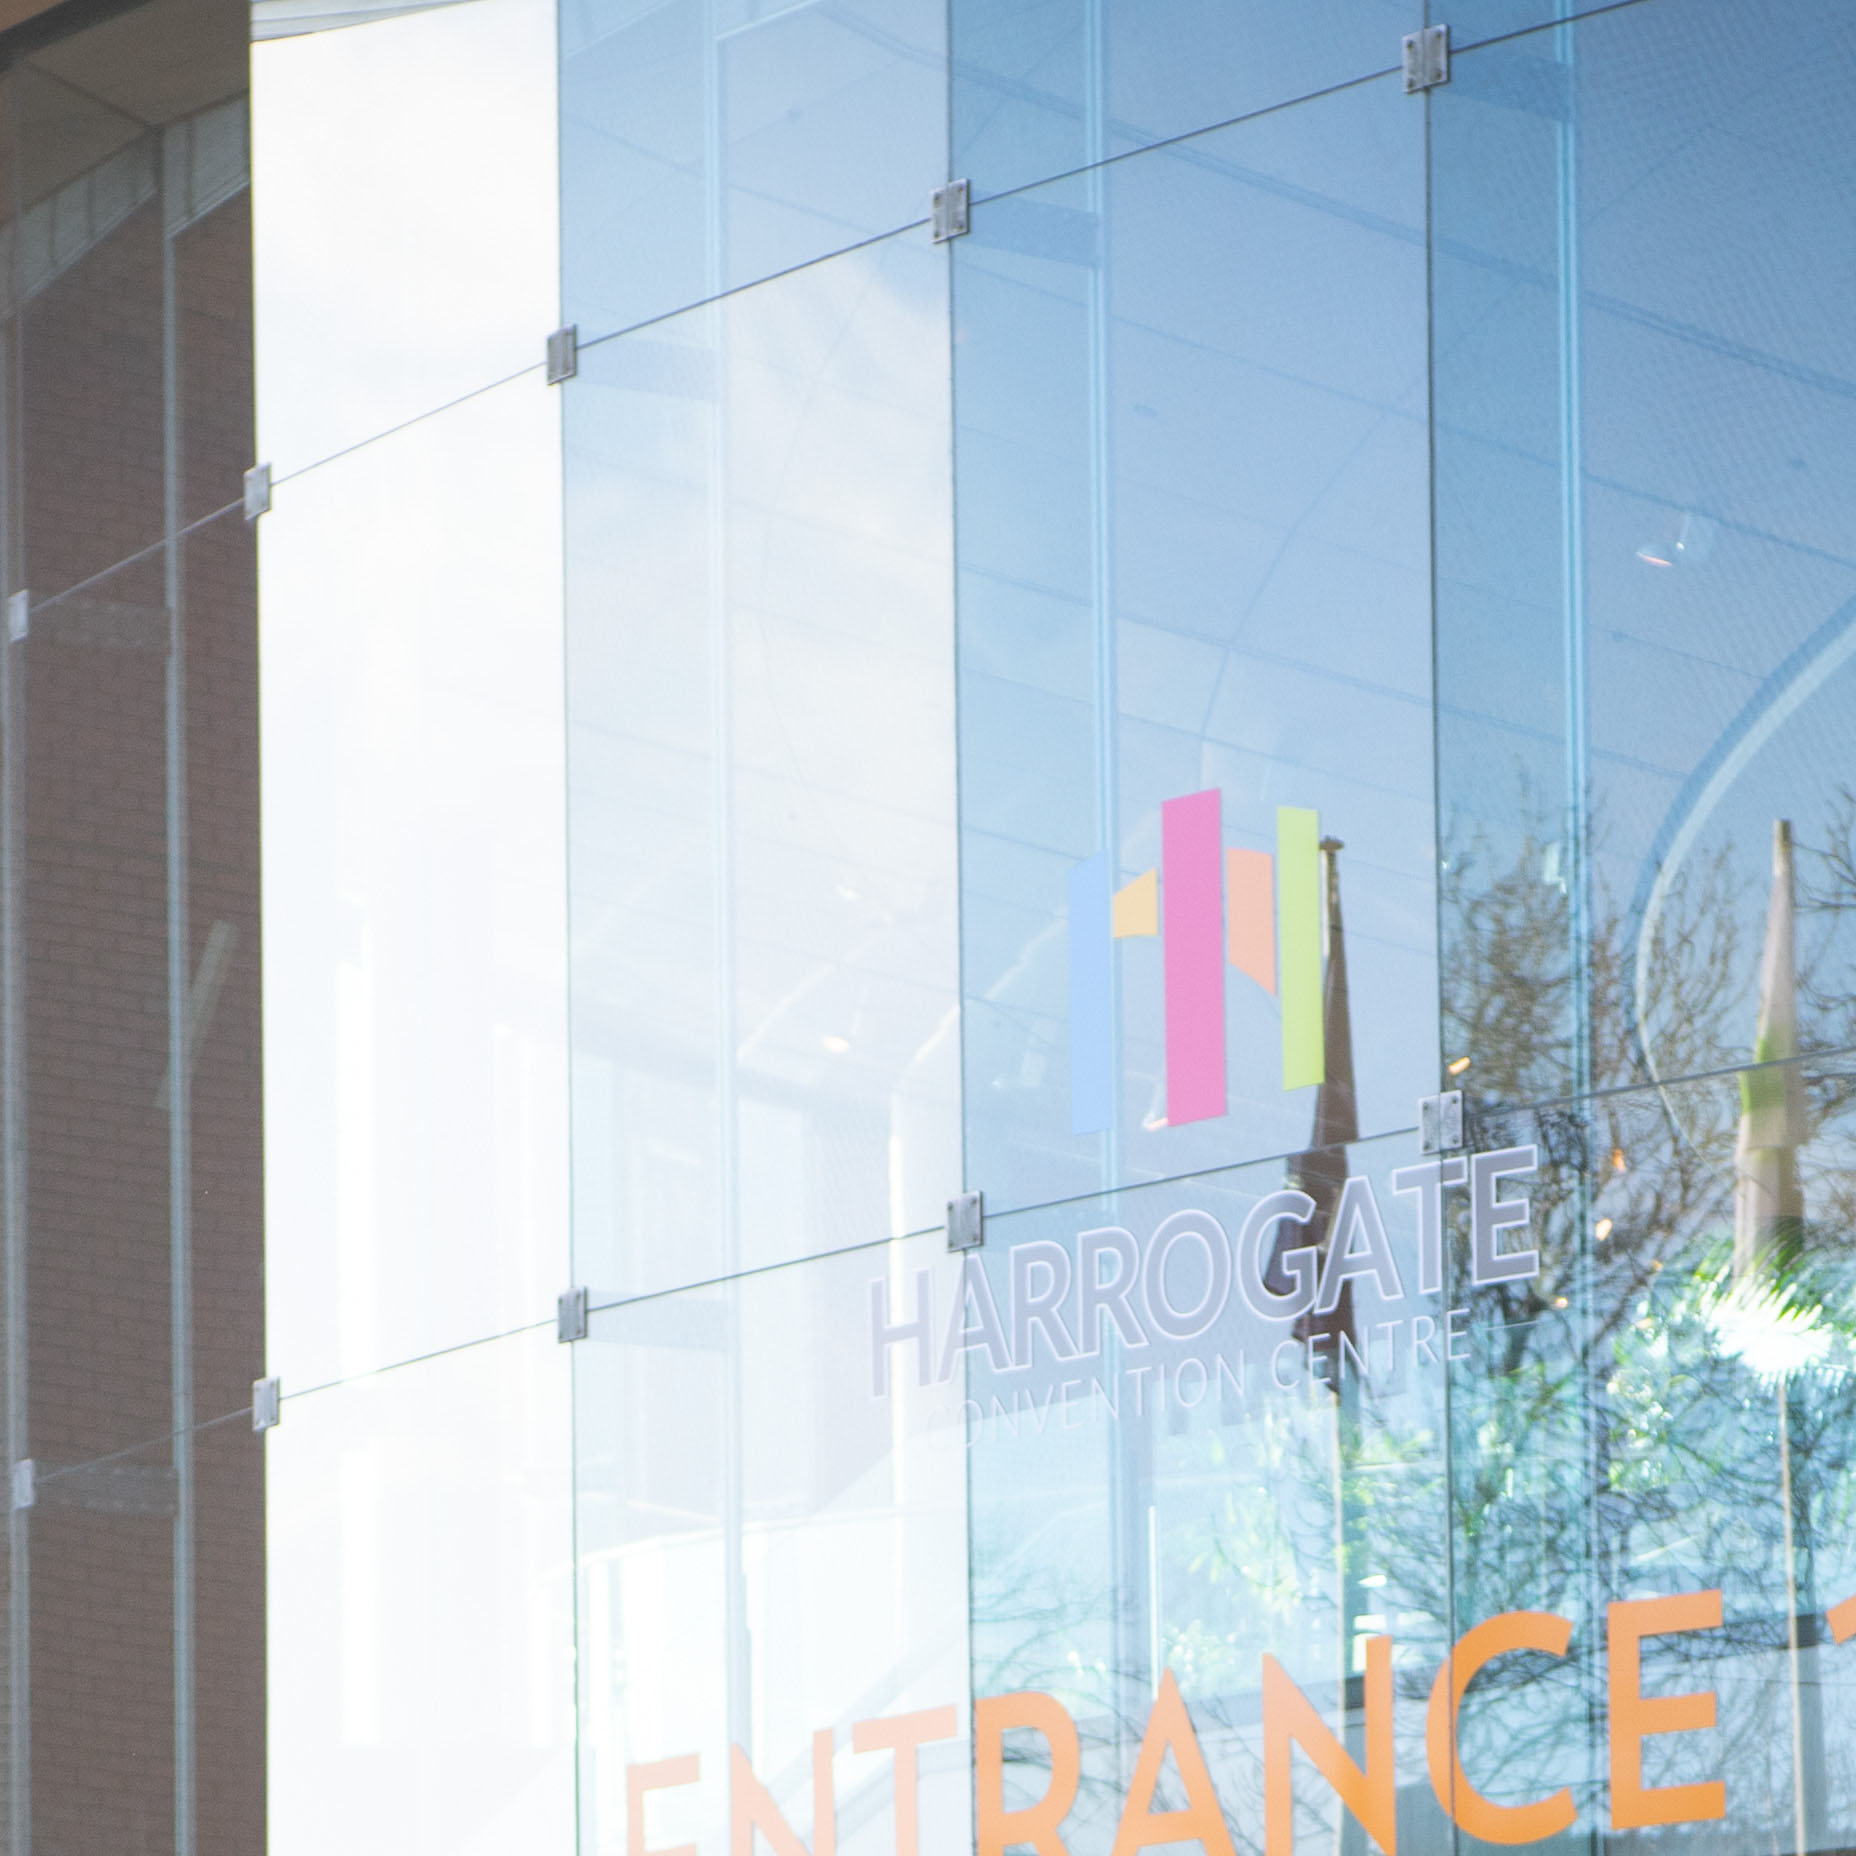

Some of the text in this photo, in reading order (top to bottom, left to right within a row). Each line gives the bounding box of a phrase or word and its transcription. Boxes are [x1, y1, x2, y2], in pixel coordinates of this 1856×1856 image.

[868, 1143, 1540, 1400] HARROGATE
[928, 1308, 1470, 1450] CONVENTION CENTRE
